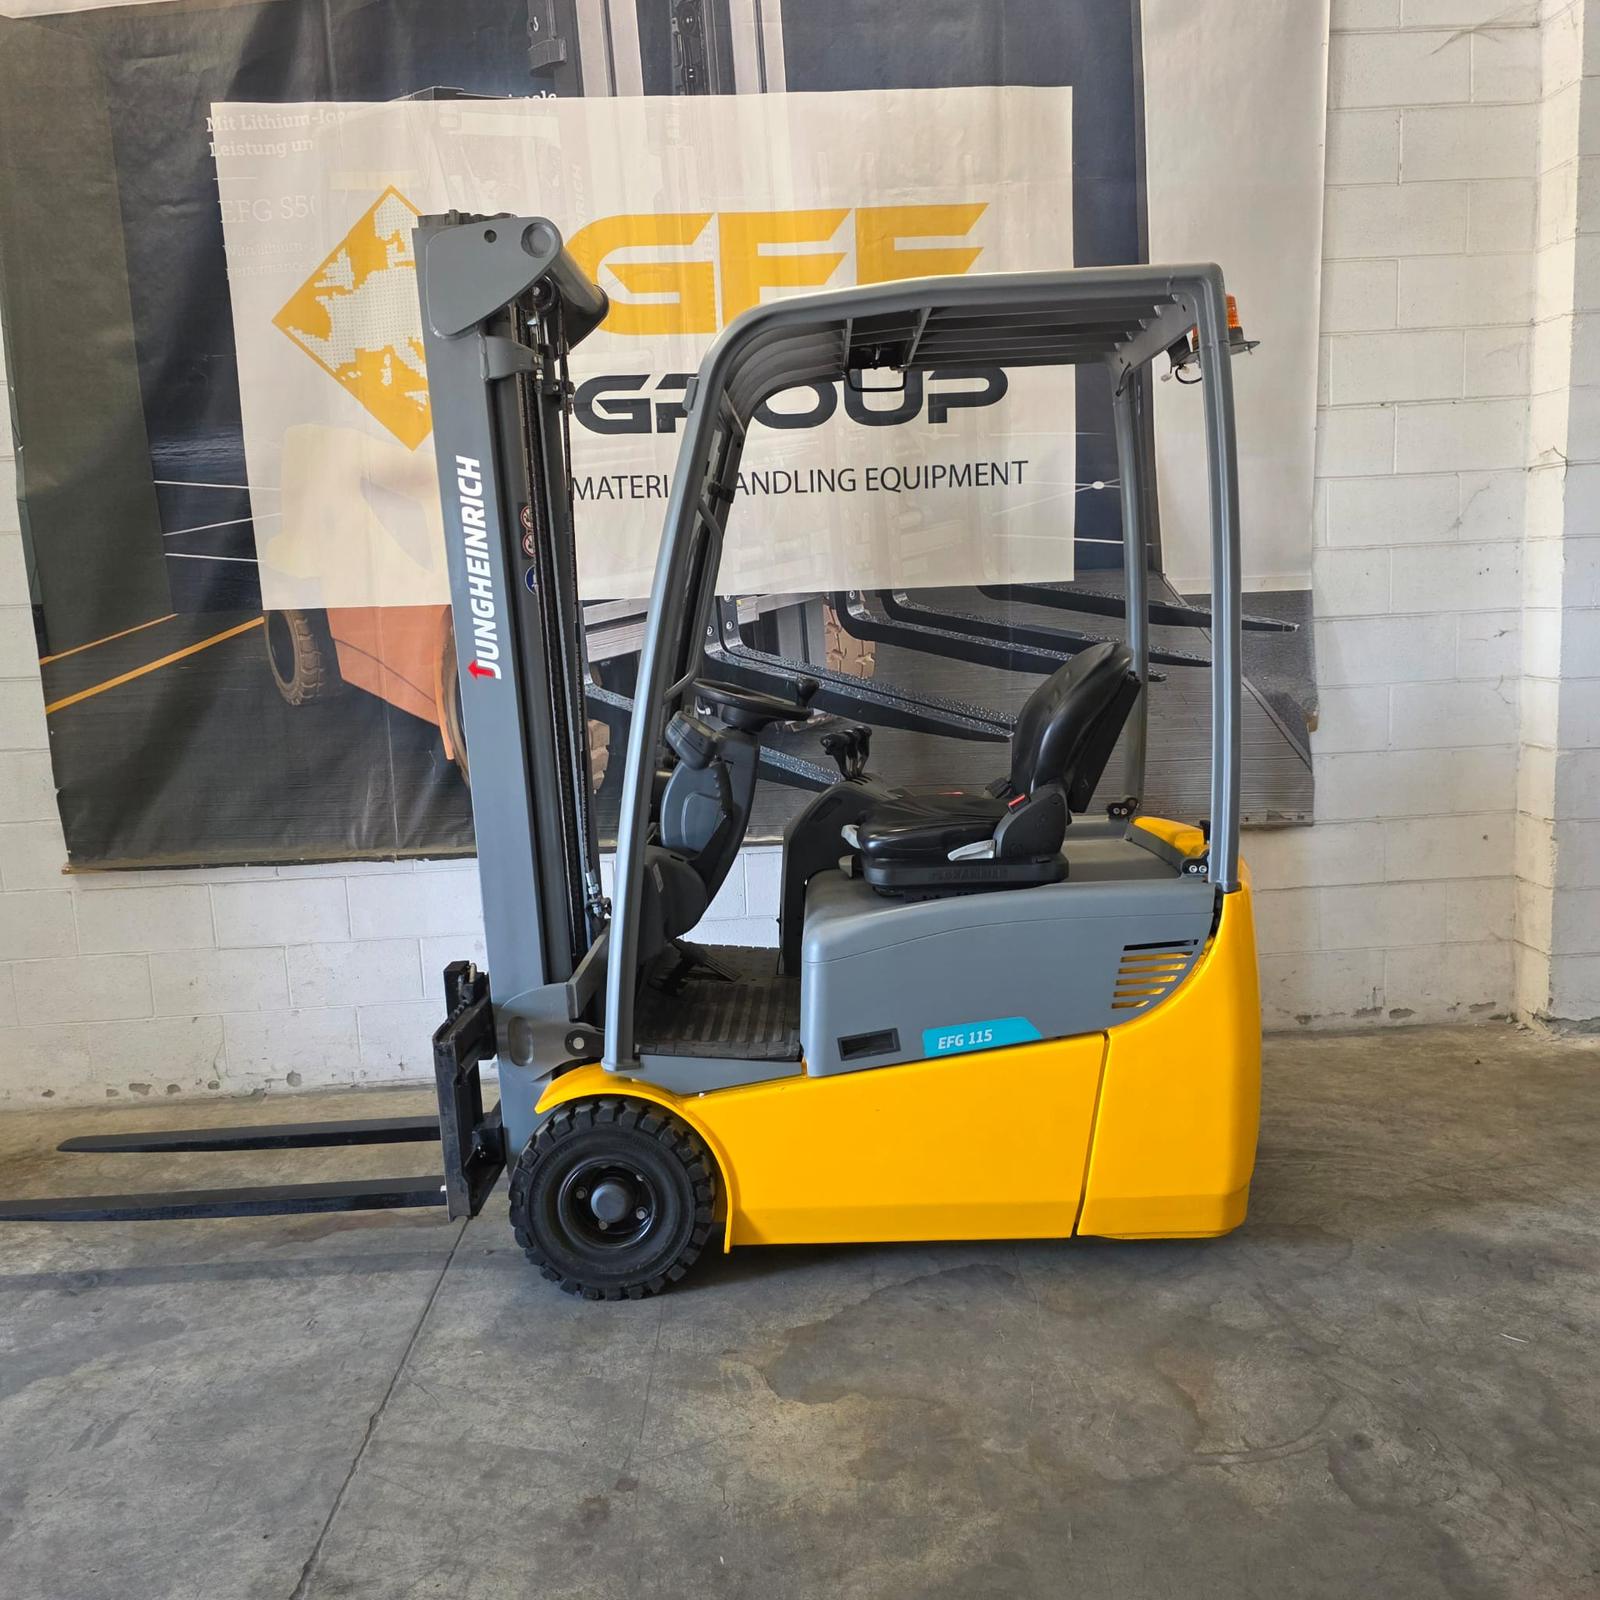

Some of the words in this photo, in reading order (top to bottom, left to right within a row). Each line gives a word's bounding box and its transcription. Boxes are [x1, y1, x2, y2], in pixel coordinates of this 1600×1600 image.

[291, 139, 314, 152] un
[217, 198, 272, 223] EFG
[571, 475, 669, 500] MATERI
[736, 468, 856, 496] ANDLING
[866, 460, 1028, 493] EQUIPMENT
[456, 455, 501, 680] JUNGHEINRICH
[937, 1033, 965, 1050] EFG
[968, 1029, 993, 1045] 115
